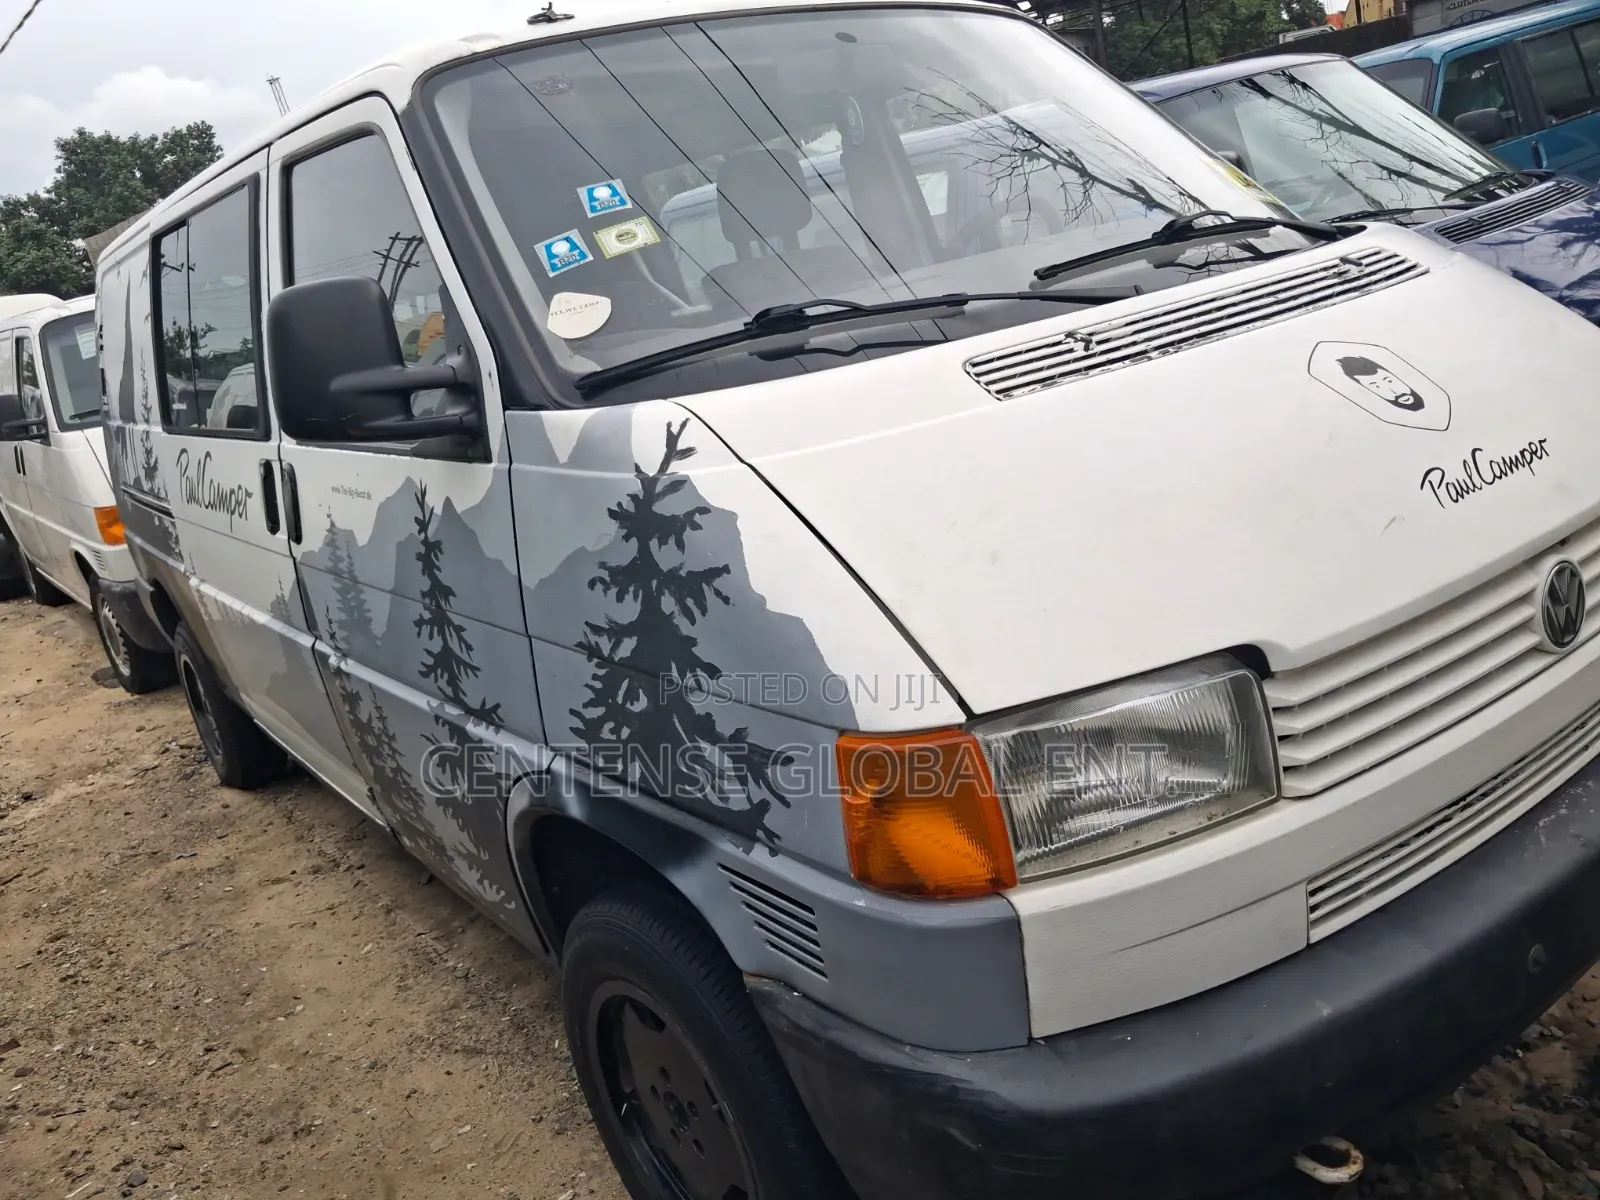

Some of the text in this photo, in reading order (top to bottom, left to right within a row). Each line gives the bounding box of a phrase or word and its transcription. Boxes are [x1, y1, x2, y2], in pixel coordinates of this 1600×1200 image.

[558, 253, 578, 266] B20
[176, 448, 253, 533] PaulCamper
[1419, 437, 1551, 509] PaulCamper
